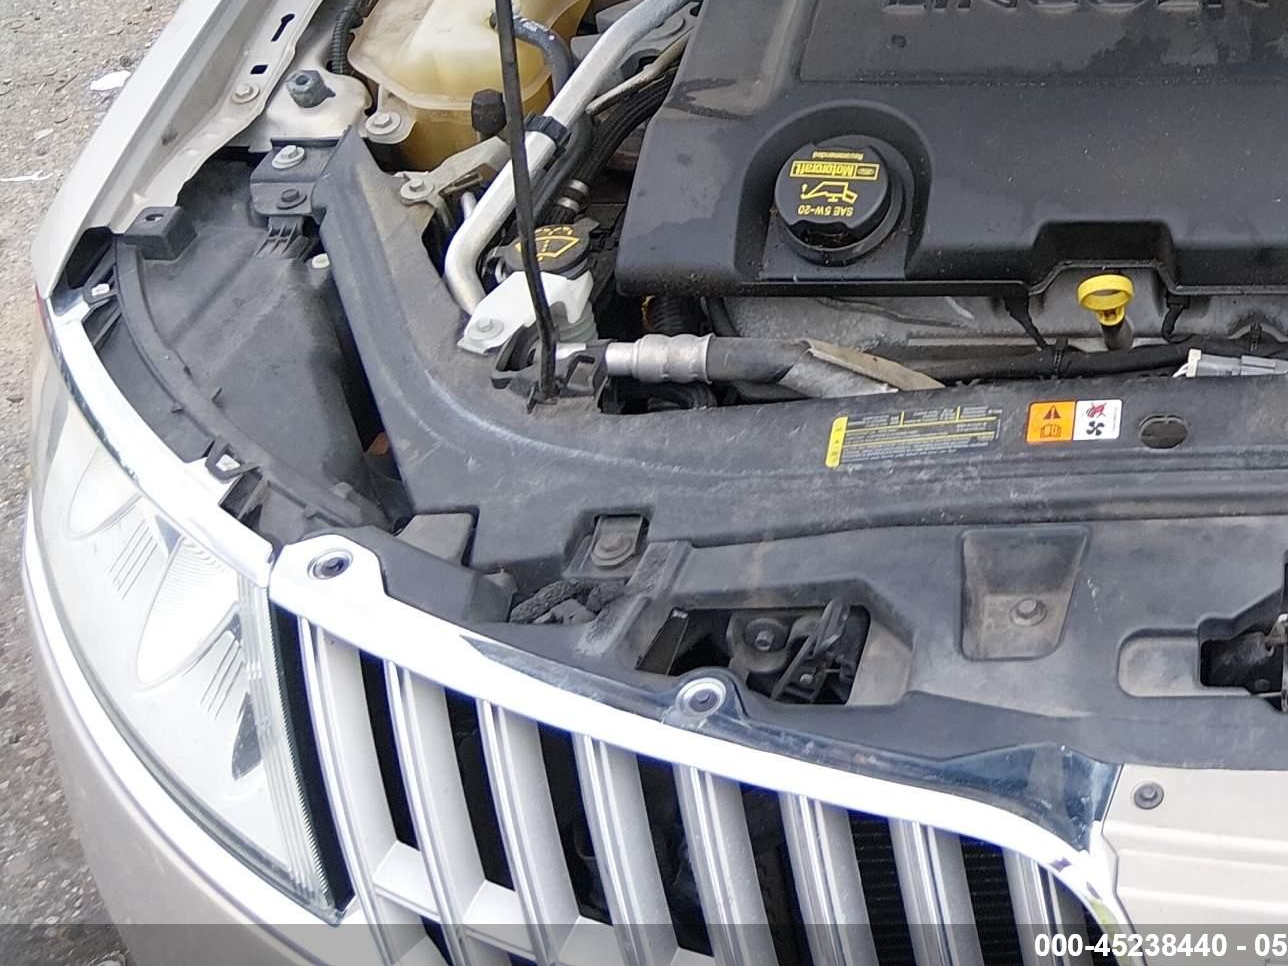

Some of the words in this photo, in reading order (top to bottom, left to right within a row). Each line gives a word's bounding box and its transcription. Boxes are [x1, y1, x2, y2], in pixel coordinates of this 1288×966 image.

[795, 163, 854, 176] Motorcraft
[797, 205, 831, 216] 5W-20
[833, 206, 854, 216] SAE
